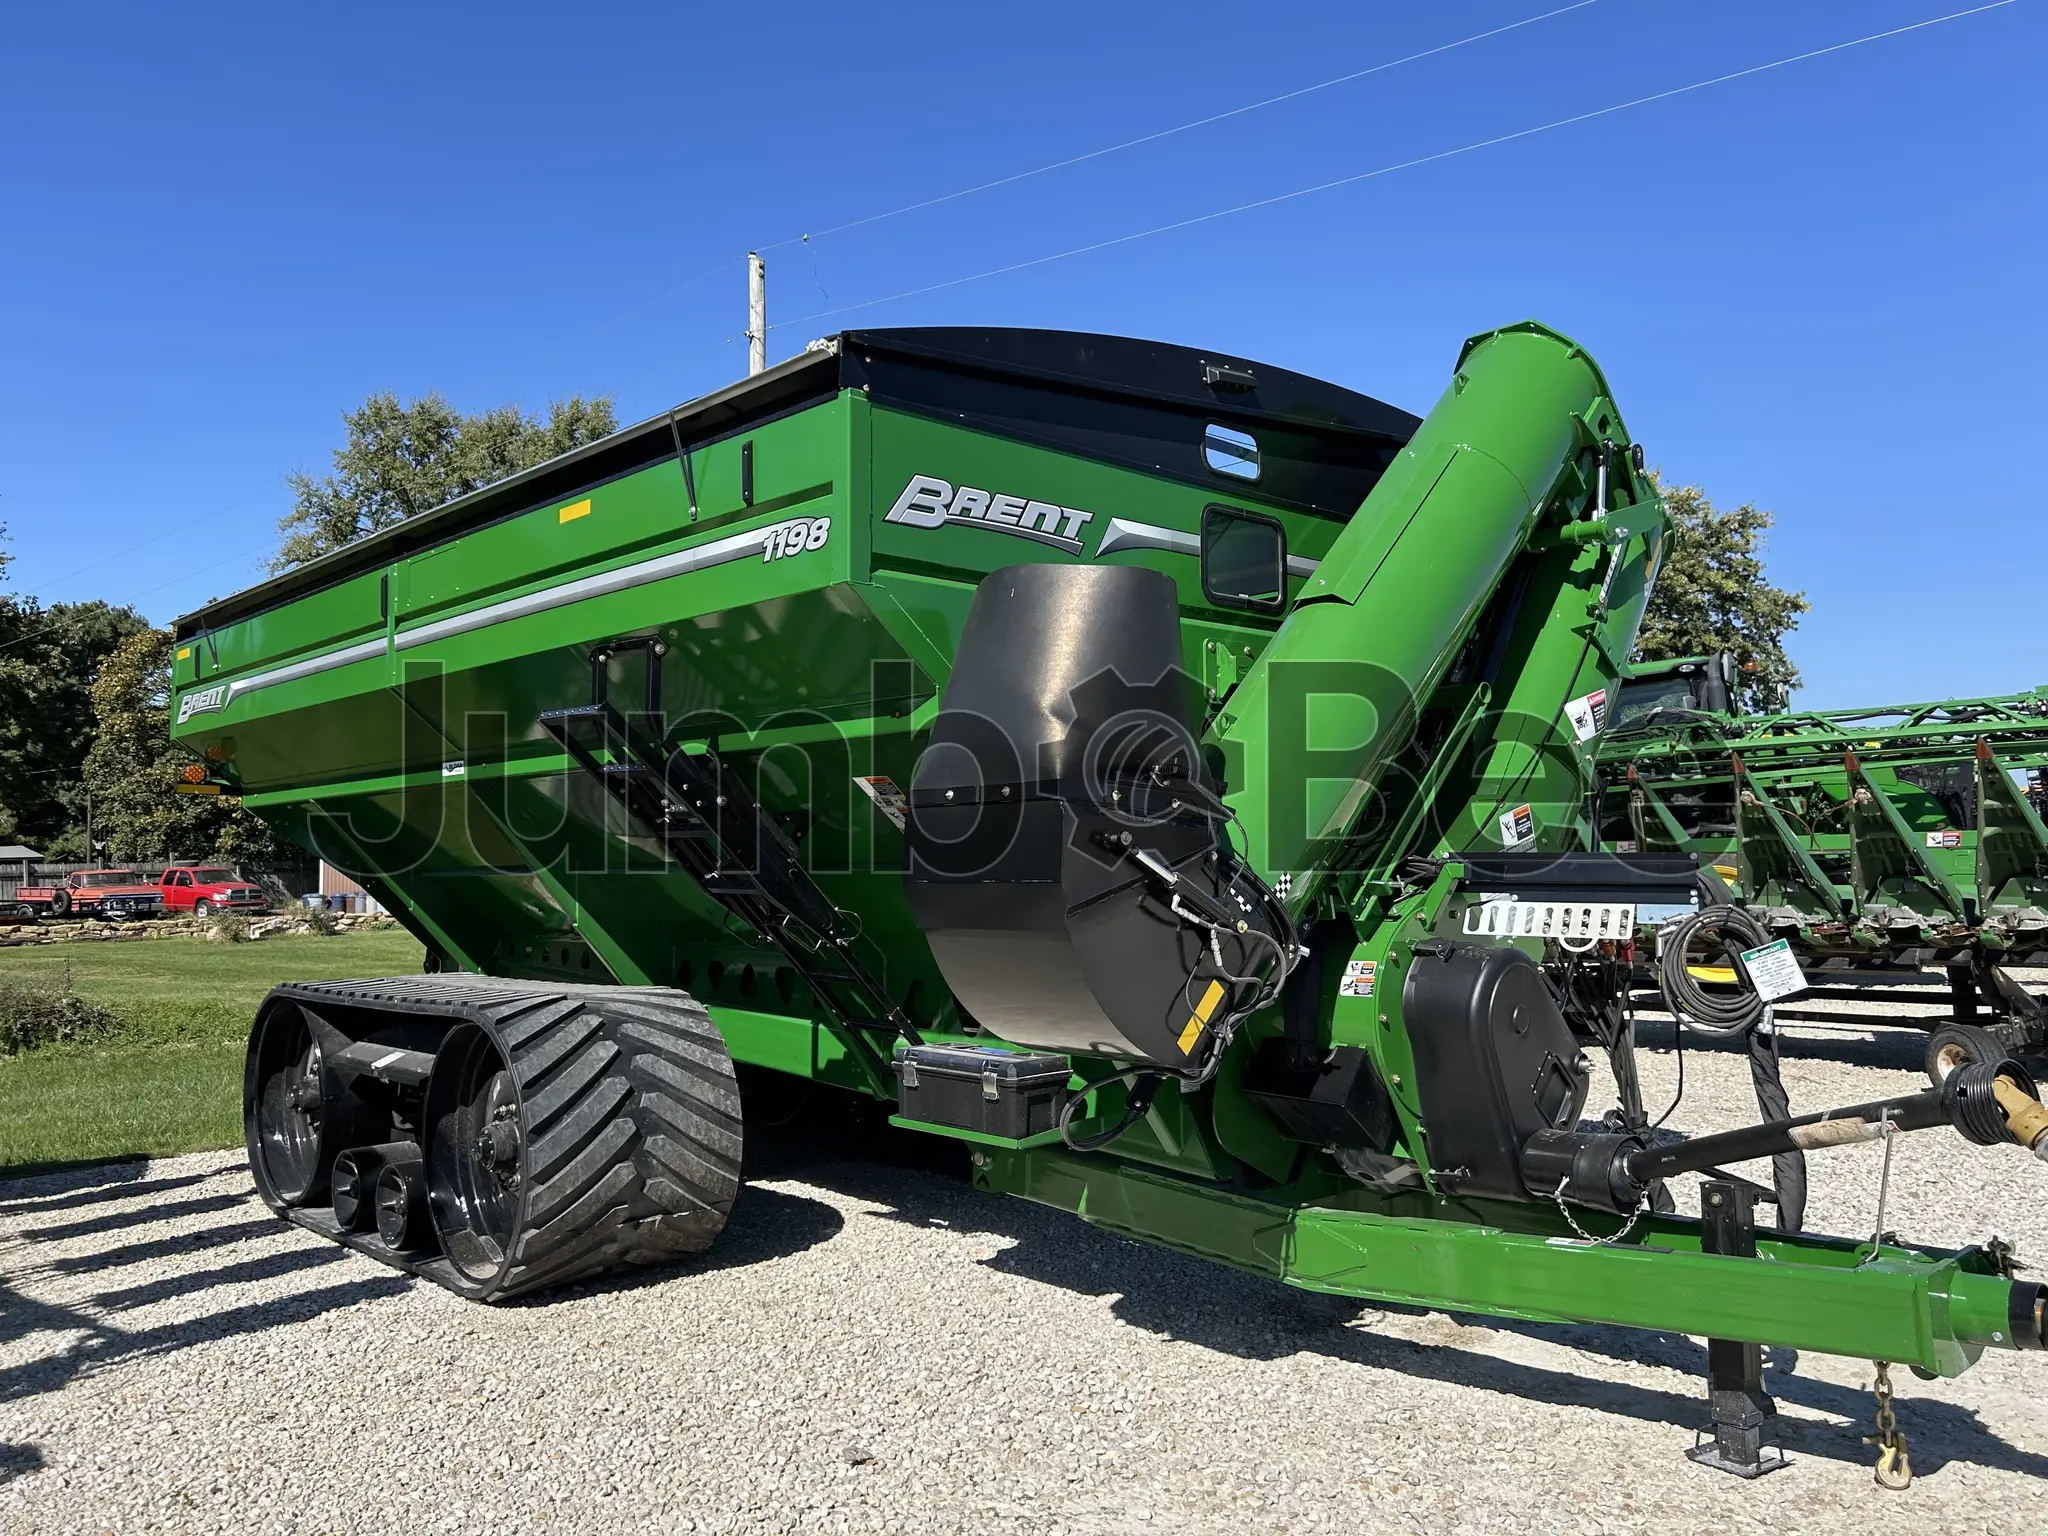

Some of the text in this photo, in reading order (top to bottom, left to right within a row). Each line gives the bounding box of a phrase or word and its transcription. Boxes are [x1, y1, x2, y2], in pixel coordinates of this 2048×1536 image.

[883, 474, 1094, 541] BRENT
[763, 516, 832, 564] 1198
[177, 685, 226, 724] BRENT
